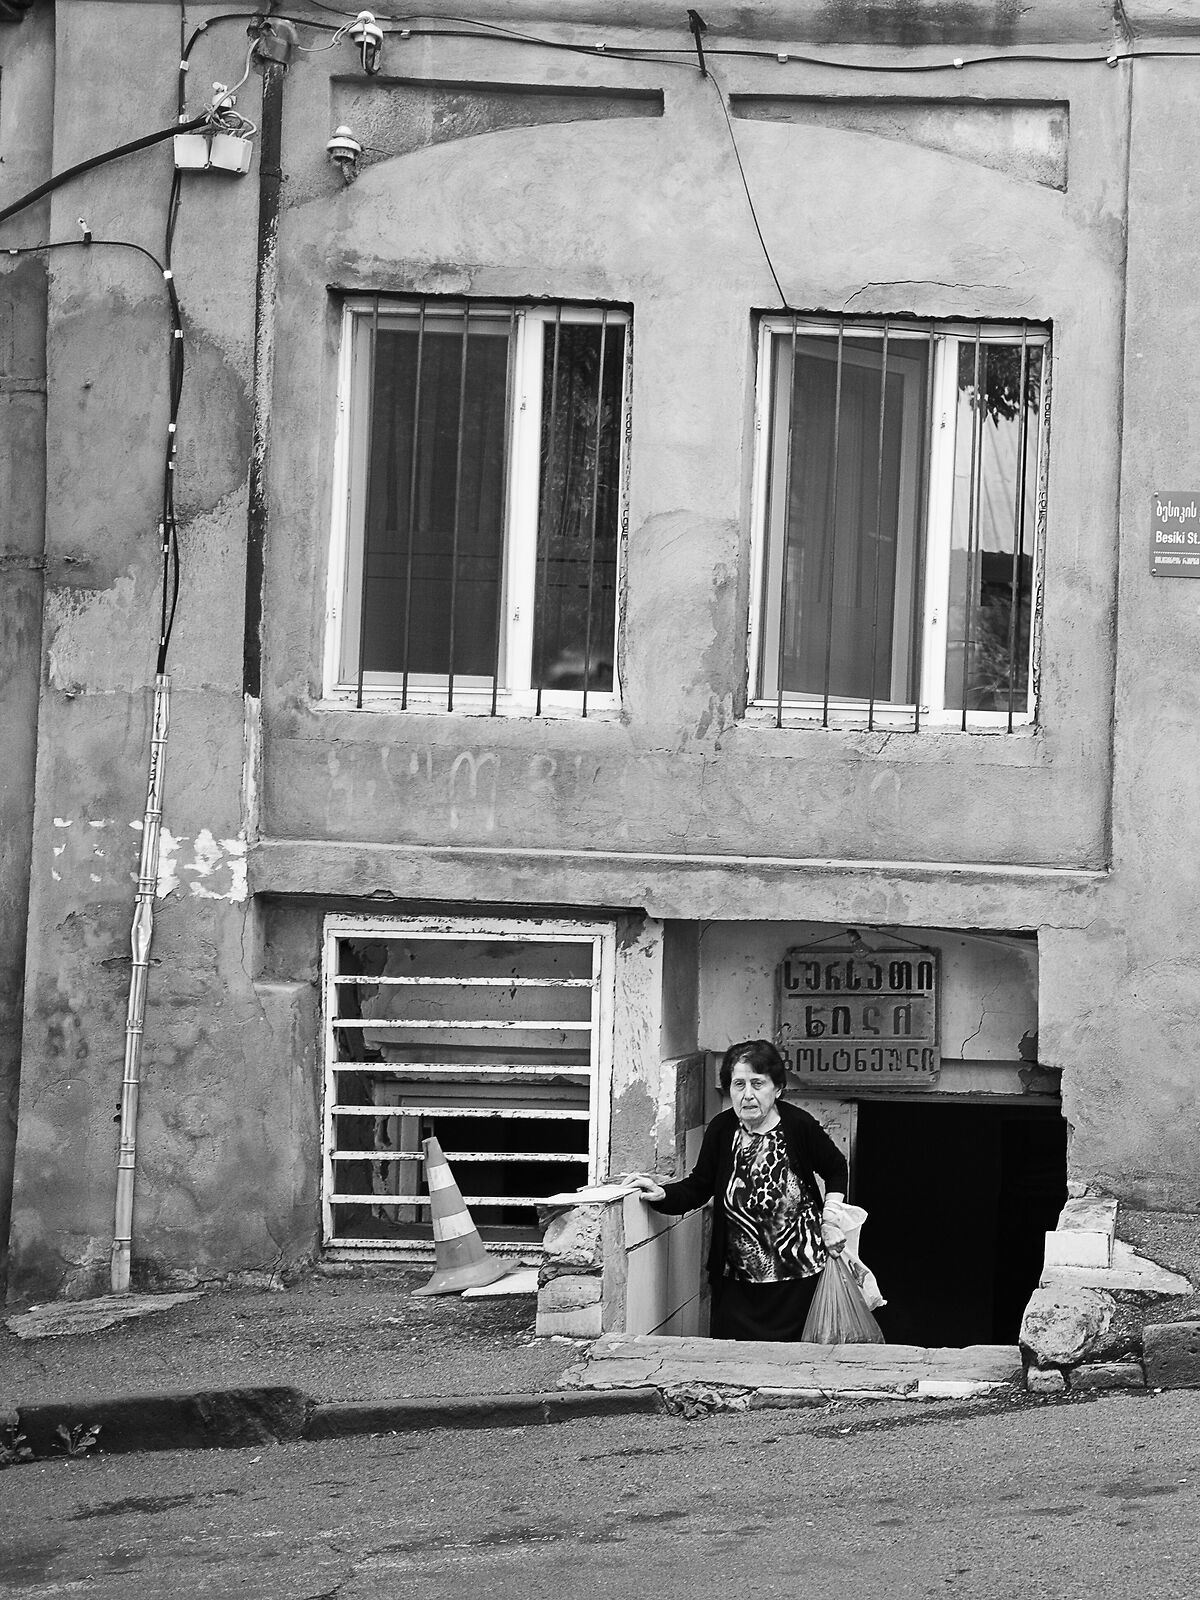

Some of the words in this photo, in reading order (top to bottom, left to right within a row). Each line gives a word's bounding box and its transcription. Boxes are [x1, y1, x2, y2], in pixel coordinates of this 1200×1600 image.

[1156, 499, 1197, 524] ბესიკის
[1155, 530, 1185, 544] Besiki
[1187, 531, 1200, 545] St.
[784, 958, 934, 991] სურსათი
[805, 1003, 913, 1037] ხილი
